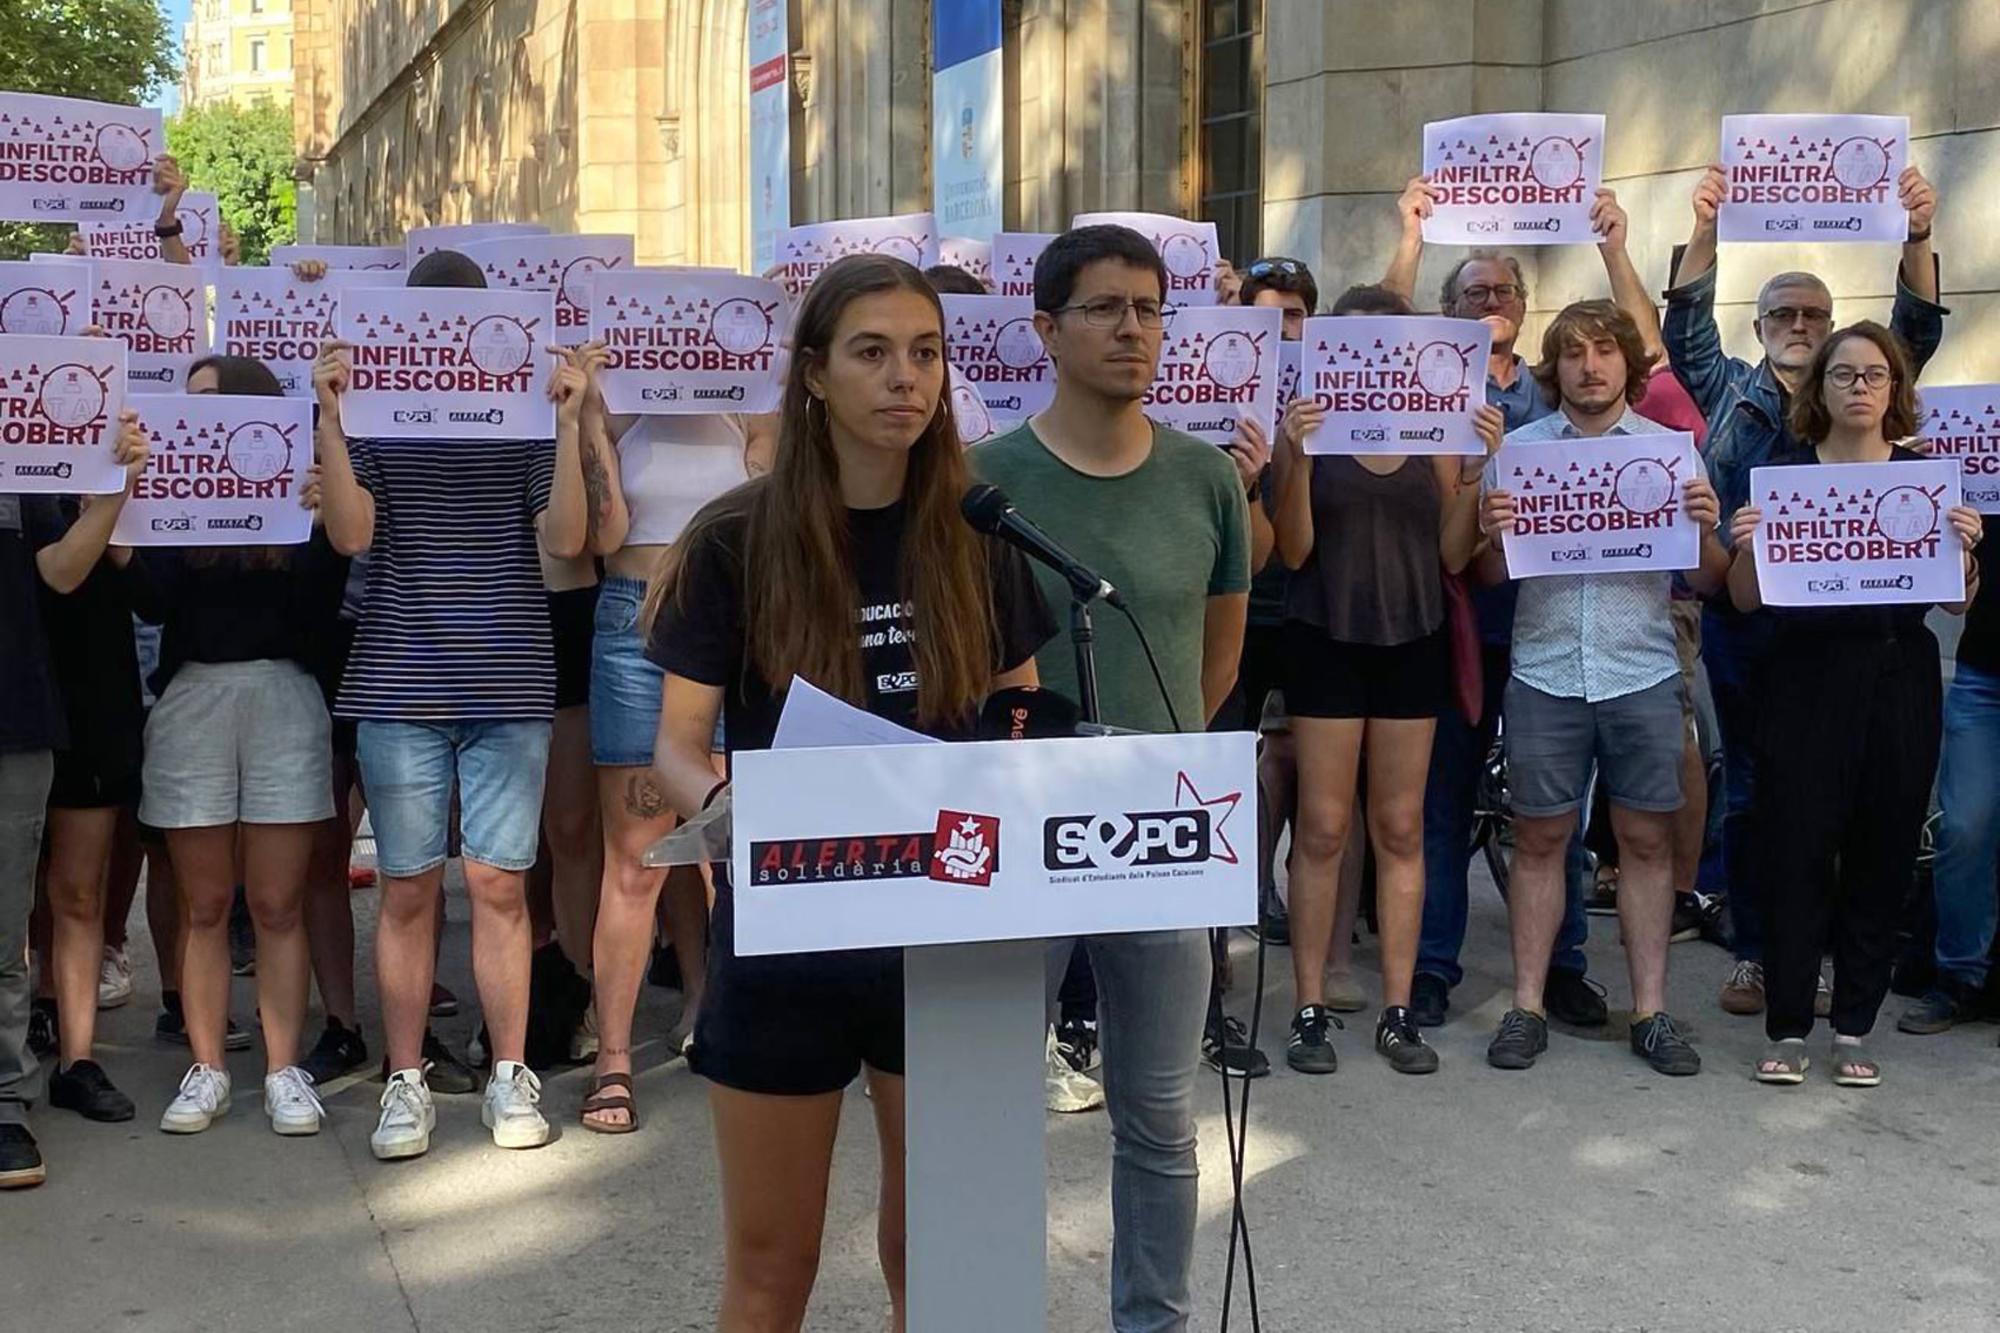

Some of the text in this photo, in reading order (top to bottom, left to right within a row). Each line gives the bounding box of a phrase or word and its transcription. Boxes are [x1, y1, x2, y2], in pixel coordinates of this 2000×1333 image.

[0, 162, 152, 185] DESCOBERT
[1433, 184, 1586, 204] DESCOBERT
[1731, 185, 1890, 204] DESCOBERT
[604, 350, 774, 370] DESCOBERT
[352, 370, 533, 392] DESCOBERT
[1315, 392, 1470, 412] DESCOBERT
[1514, 507, 1678, 536] DESCOBERT
[1767, 538, 1941, 564] DESCOBERT
[759, 837, 921, 868] ALERTA
[759, 859, 922, 882] solidària
